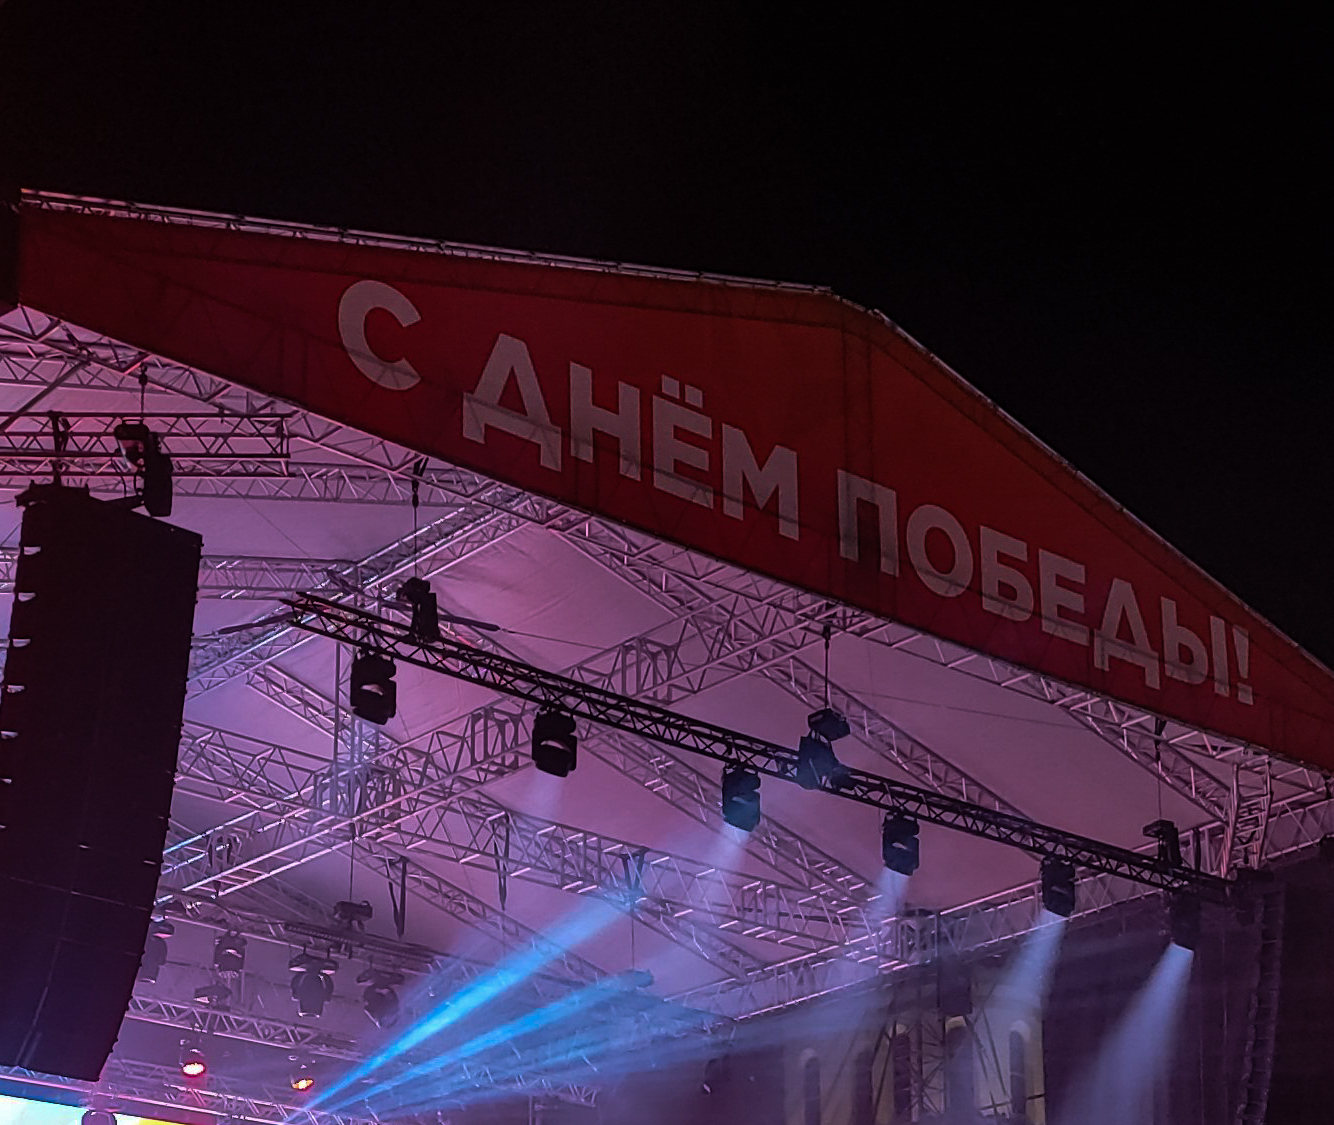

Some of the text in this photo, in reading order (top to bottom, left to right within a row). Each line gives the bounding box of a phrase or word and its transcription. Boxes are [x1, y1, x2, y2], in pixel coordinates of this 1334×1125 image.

[339, 279, 1253, 704] С ДНЁМ ПОБЕДЫ!
